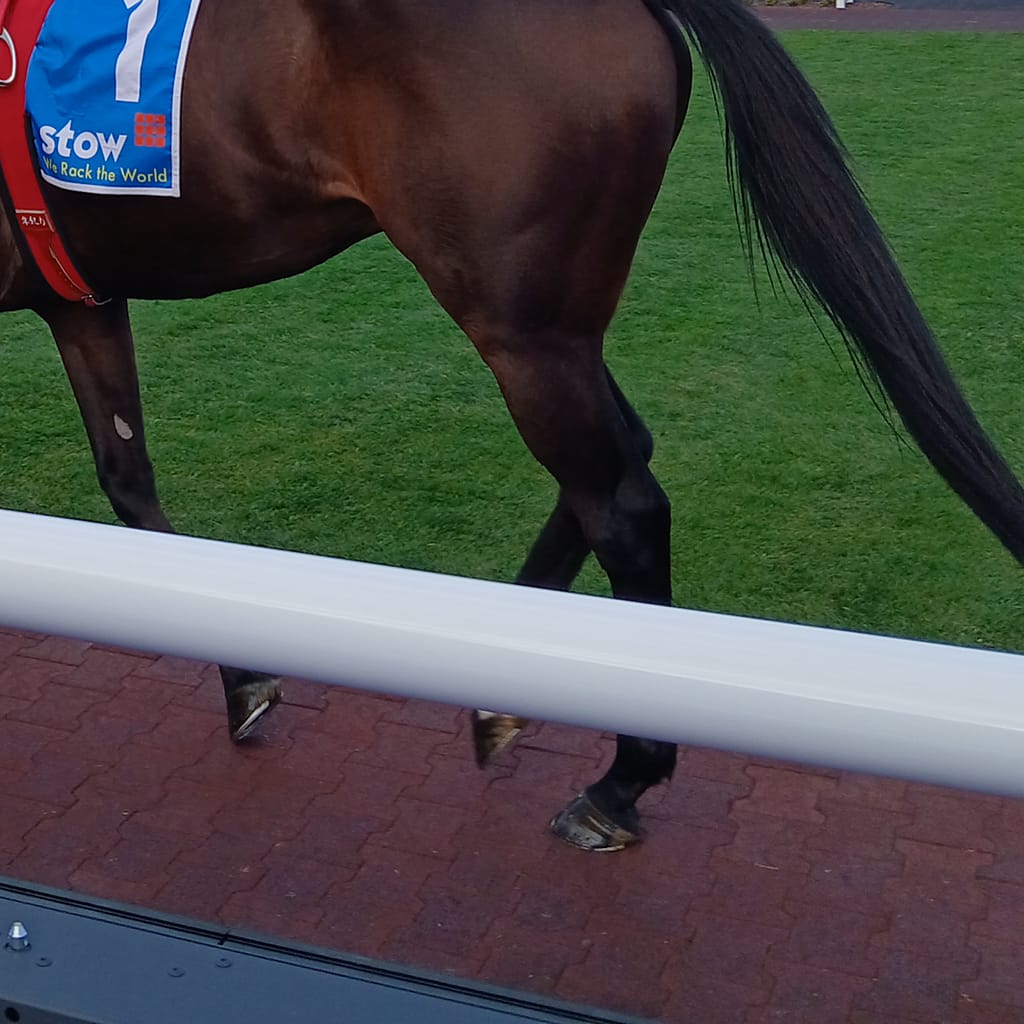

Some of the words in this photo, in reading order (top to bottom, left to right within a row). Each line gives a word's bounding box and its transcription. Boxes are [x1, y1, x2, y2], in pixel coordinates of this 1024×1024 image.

[39, 119, 128, 163] stow
[61, 161, 92, 180] Rack
[96, 165, 116, 182] the
[119, 167, 168, 183] World
